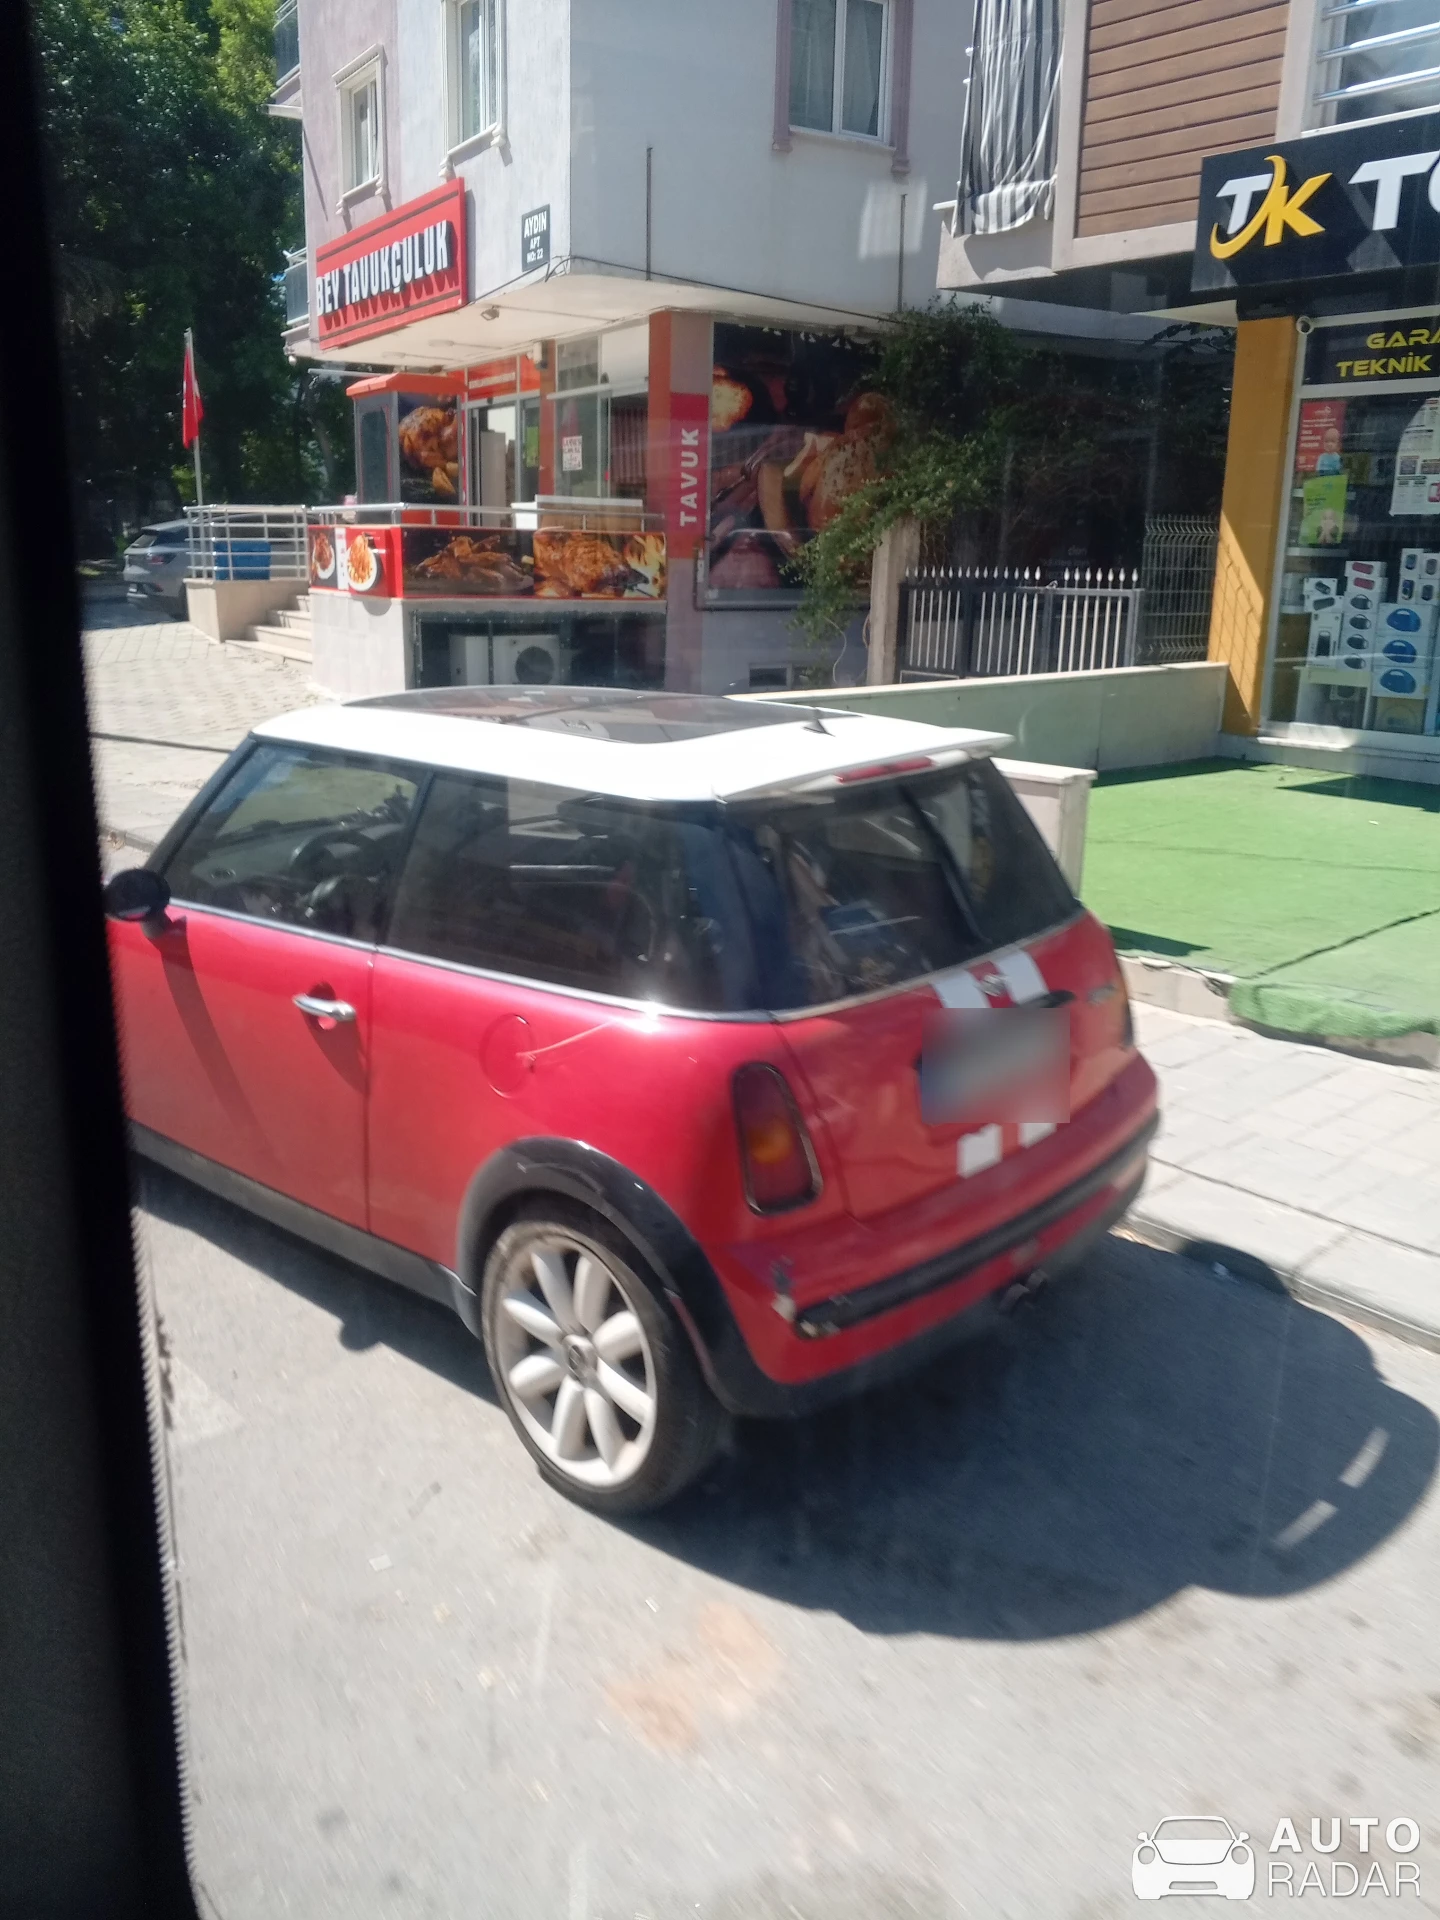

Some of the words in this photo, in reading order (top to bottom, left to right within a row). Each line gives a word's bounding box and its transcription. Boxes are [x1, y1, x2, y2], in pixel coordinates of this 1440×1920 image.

[524, 211, 546, 238] AYDIN
[530, 236, 541, 250] APT
[537, 248, 543, 260] 22
[316, 268, 340, 317] BEY
[343, 219, 448, 306] TAVUKÇULUK
[1336, 352, 1433, 377] TEKNİK
[680, 428, 699, 527] TAVUK
